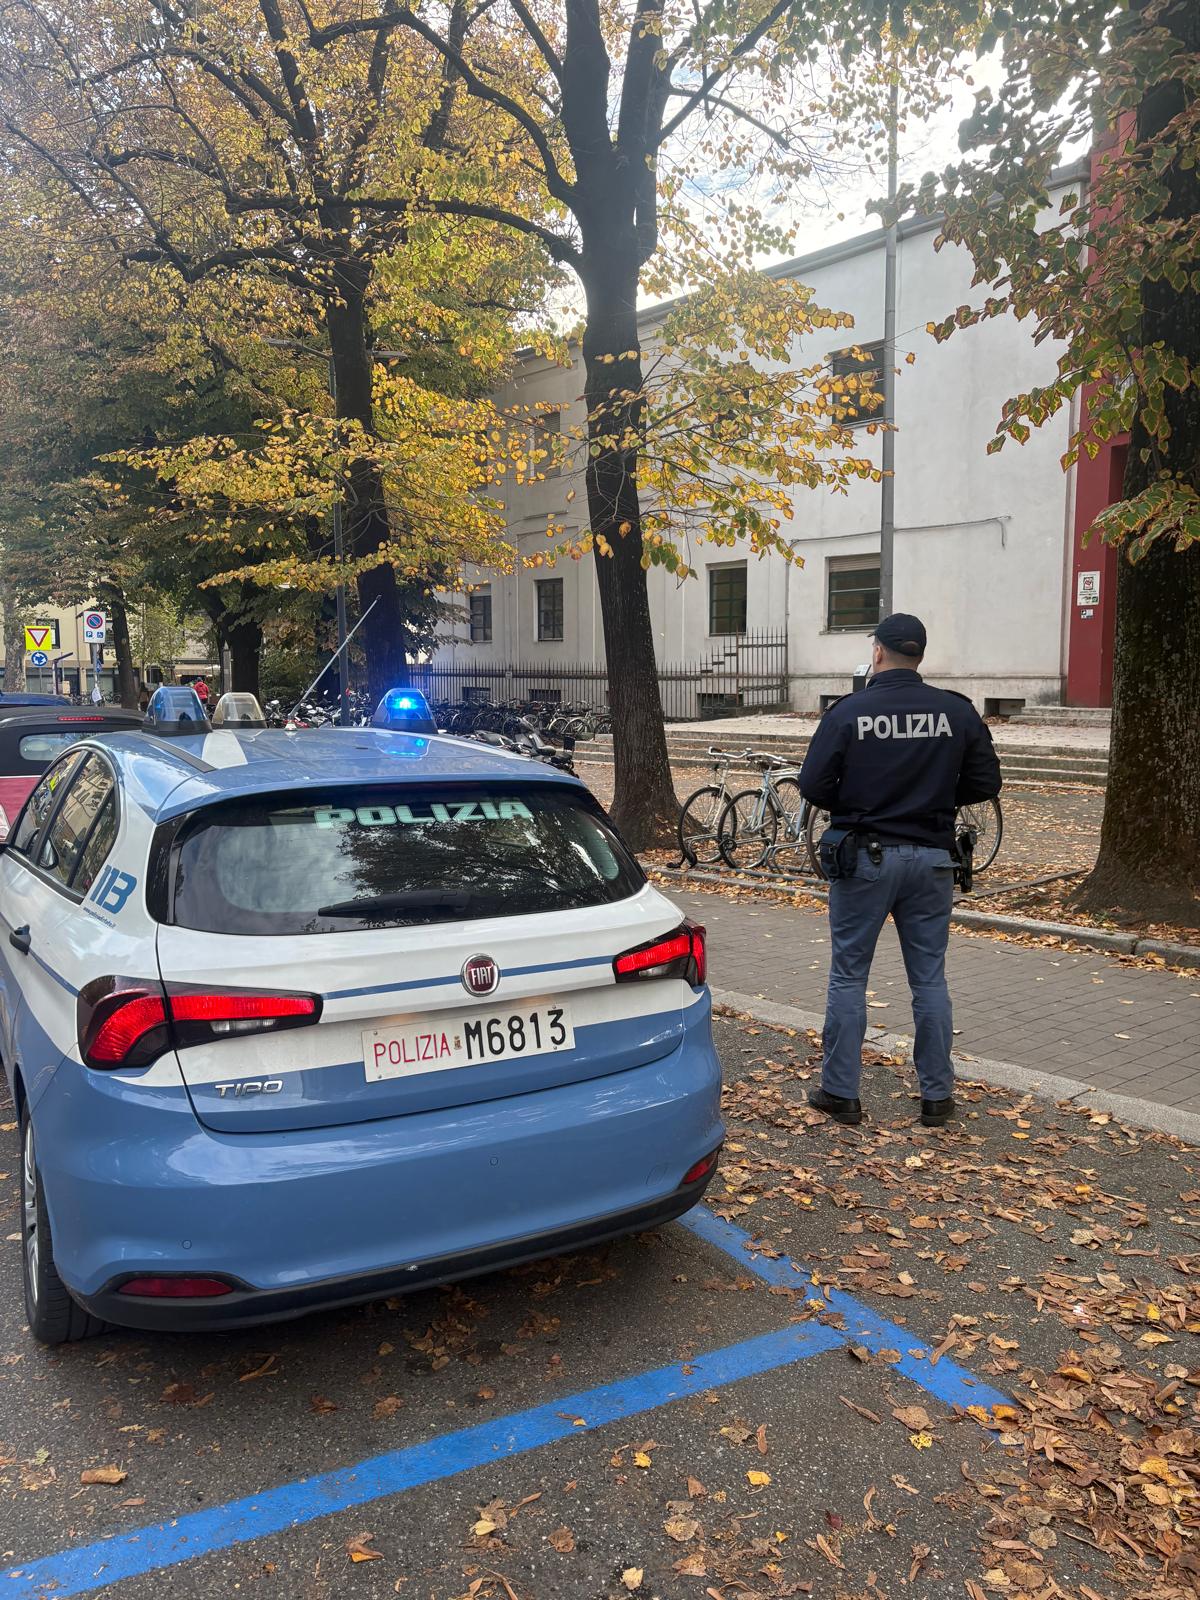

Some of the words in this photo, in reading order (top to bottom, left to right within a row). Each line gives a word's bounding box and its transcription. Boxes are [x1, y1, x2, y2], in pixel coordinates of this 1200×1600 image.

[857, 713, 953, 740] POLIZIA
[314, 801, 534, 829] POLIZIA
[90, 864, 137, 914] 113
[471, 966, 493, 986] FIAT
[373, 1032, 452, 1067] POLIZIA
[463, 1008, 566, 1060] M6813
[215, 1080, 283, 1098] TIPO
